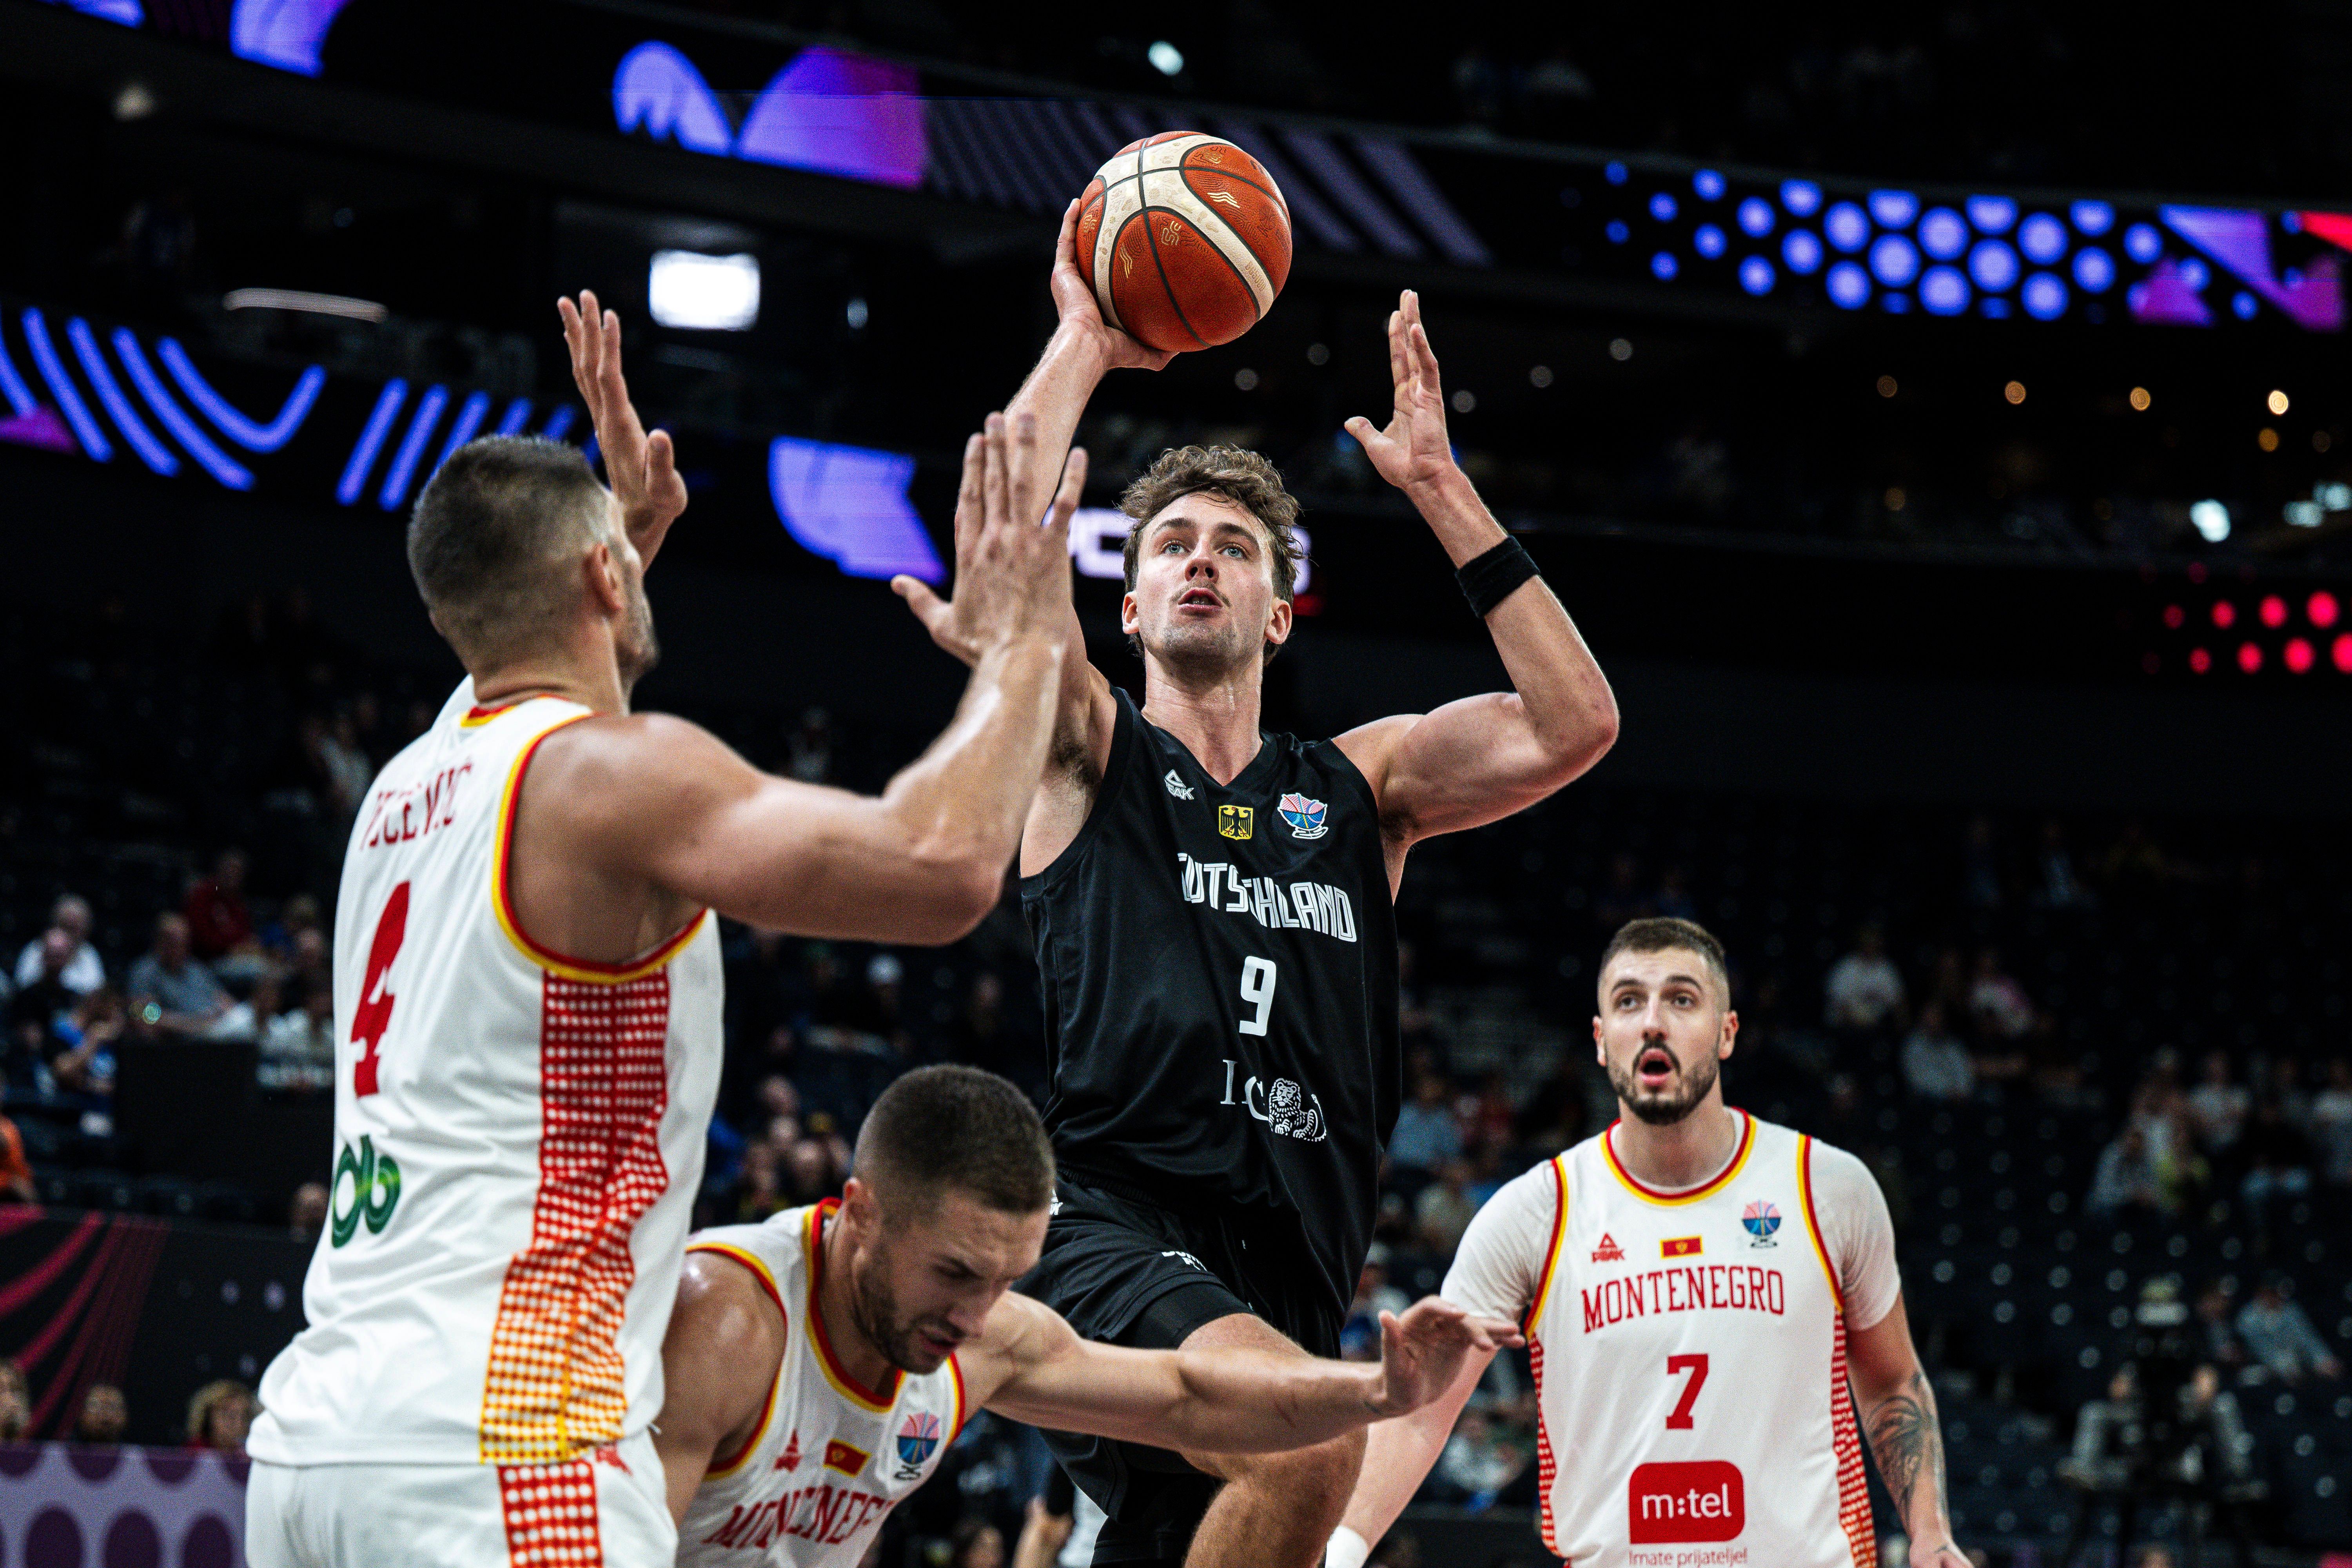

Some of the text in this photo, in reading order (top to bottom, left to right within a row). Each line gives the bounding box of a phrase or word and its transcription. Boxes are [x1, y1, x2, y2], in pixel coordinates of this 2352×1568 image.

[351, 881, 410, 1098] 4
[1239, 955, 1277, 1036] 9
[1581, 1265, 1784, 1334] MONTENEGRO
[1666, 1353, 1709, 1430] 7
[1642, 1483, 1732, 1519] m:tel
[1628, 1549, 1673, 1566] Imate
